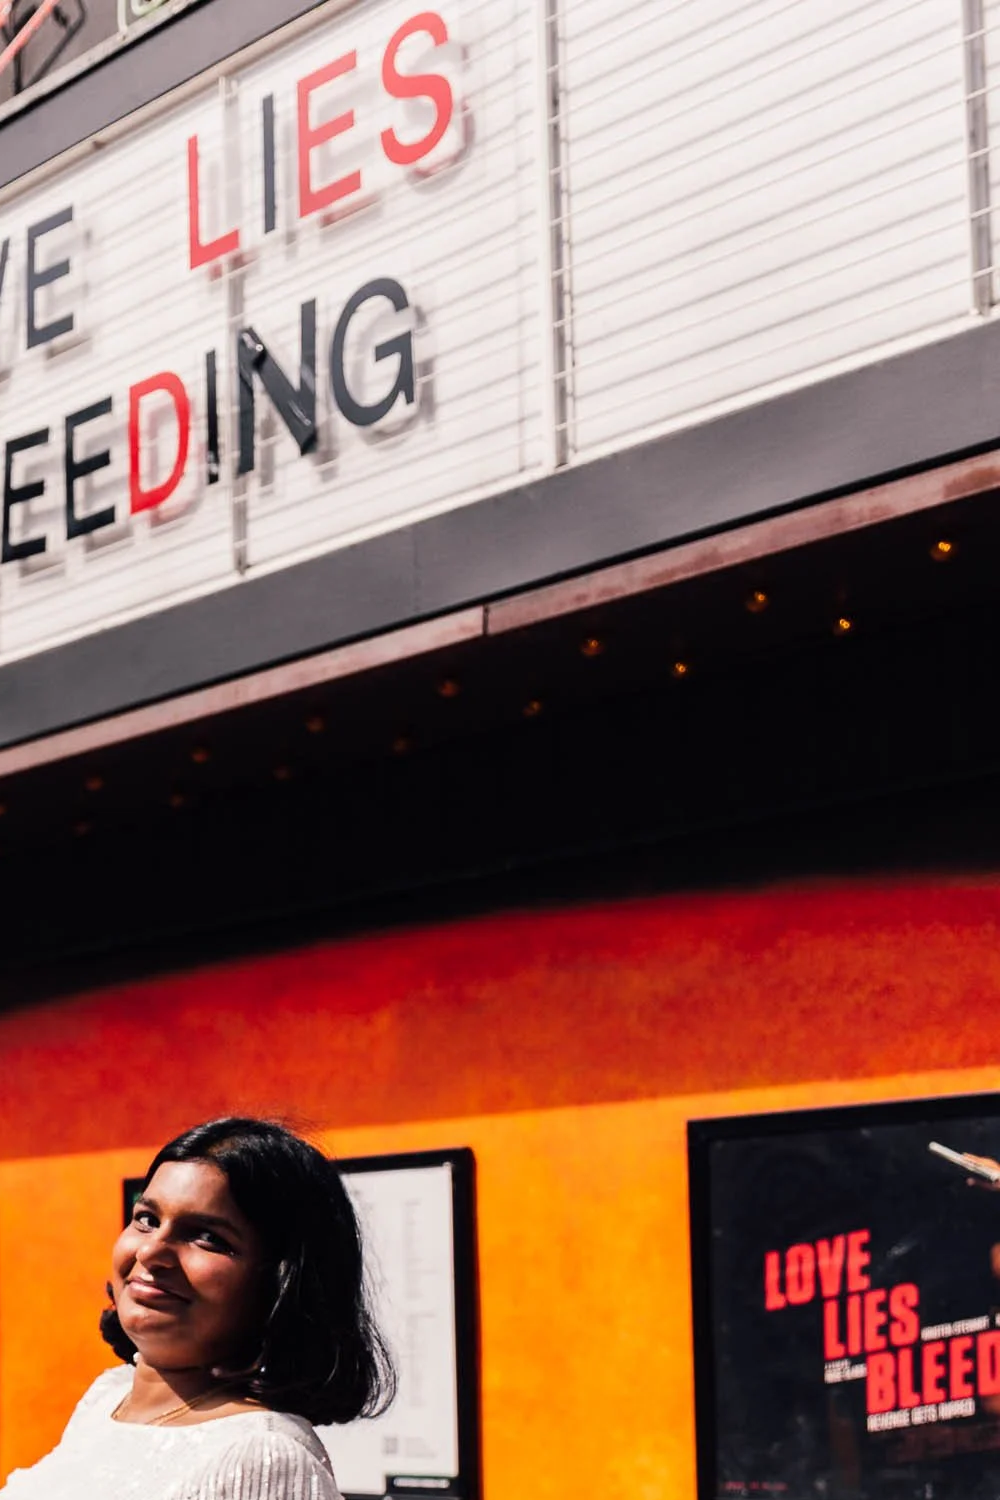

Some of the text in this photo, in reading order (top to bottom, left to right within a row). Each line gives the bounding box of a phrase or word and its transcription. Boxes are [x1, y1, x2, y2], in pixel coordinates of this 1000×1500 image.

[187, 11, 454, 270] LIES
[764, 1228, 871, 1311] LOVE
[823, 1281, 920, 1361] LIES
